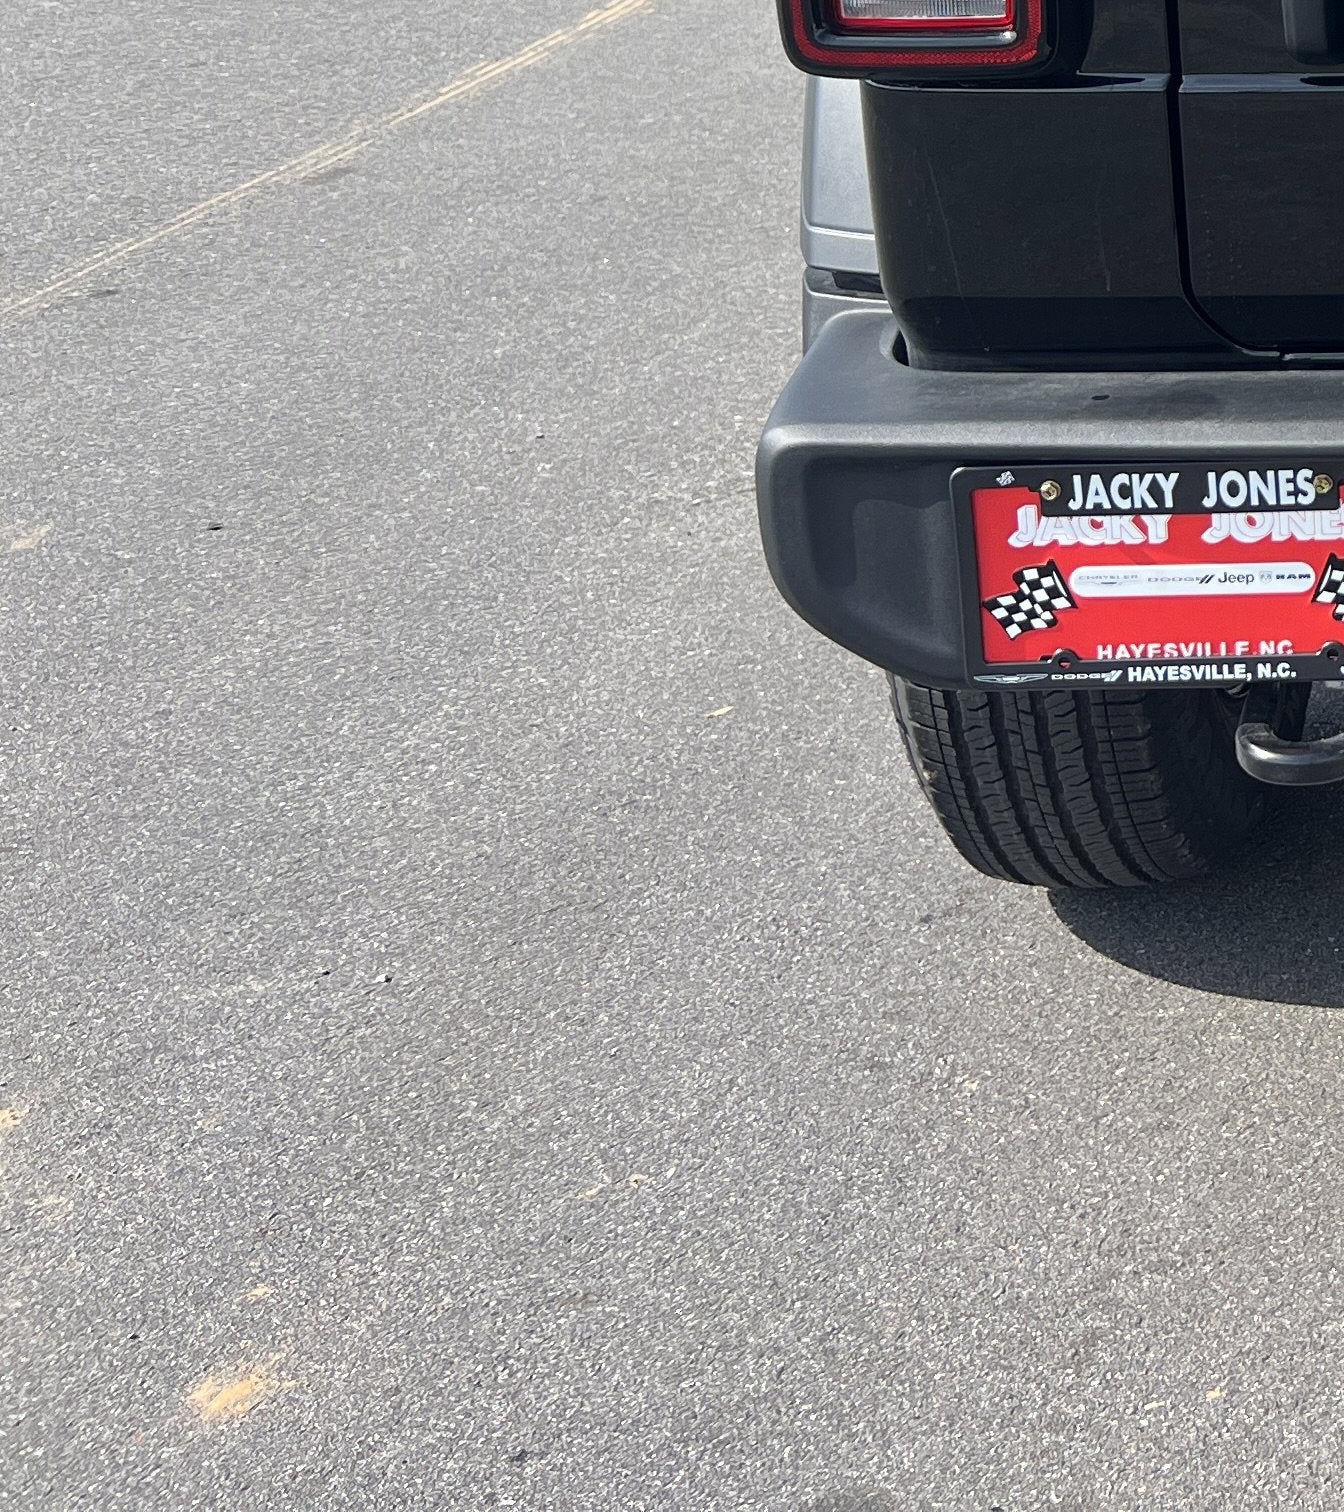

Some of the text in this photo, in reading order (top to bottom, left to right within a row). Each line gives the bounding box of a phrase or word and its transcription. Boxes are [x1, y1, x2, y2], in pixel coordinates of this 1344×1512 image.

[1068, 468, 1316, 511] JACKY JONES
[1008, 504, 1174, 548] JACKY
[1218, 571, 1255, 585] Jeep
[1275, 572, 1311, 580] RAM
[1127, 663, 1253, 682] HAYESVILLE,
[1257, 662, 1297, 678] N.C.
